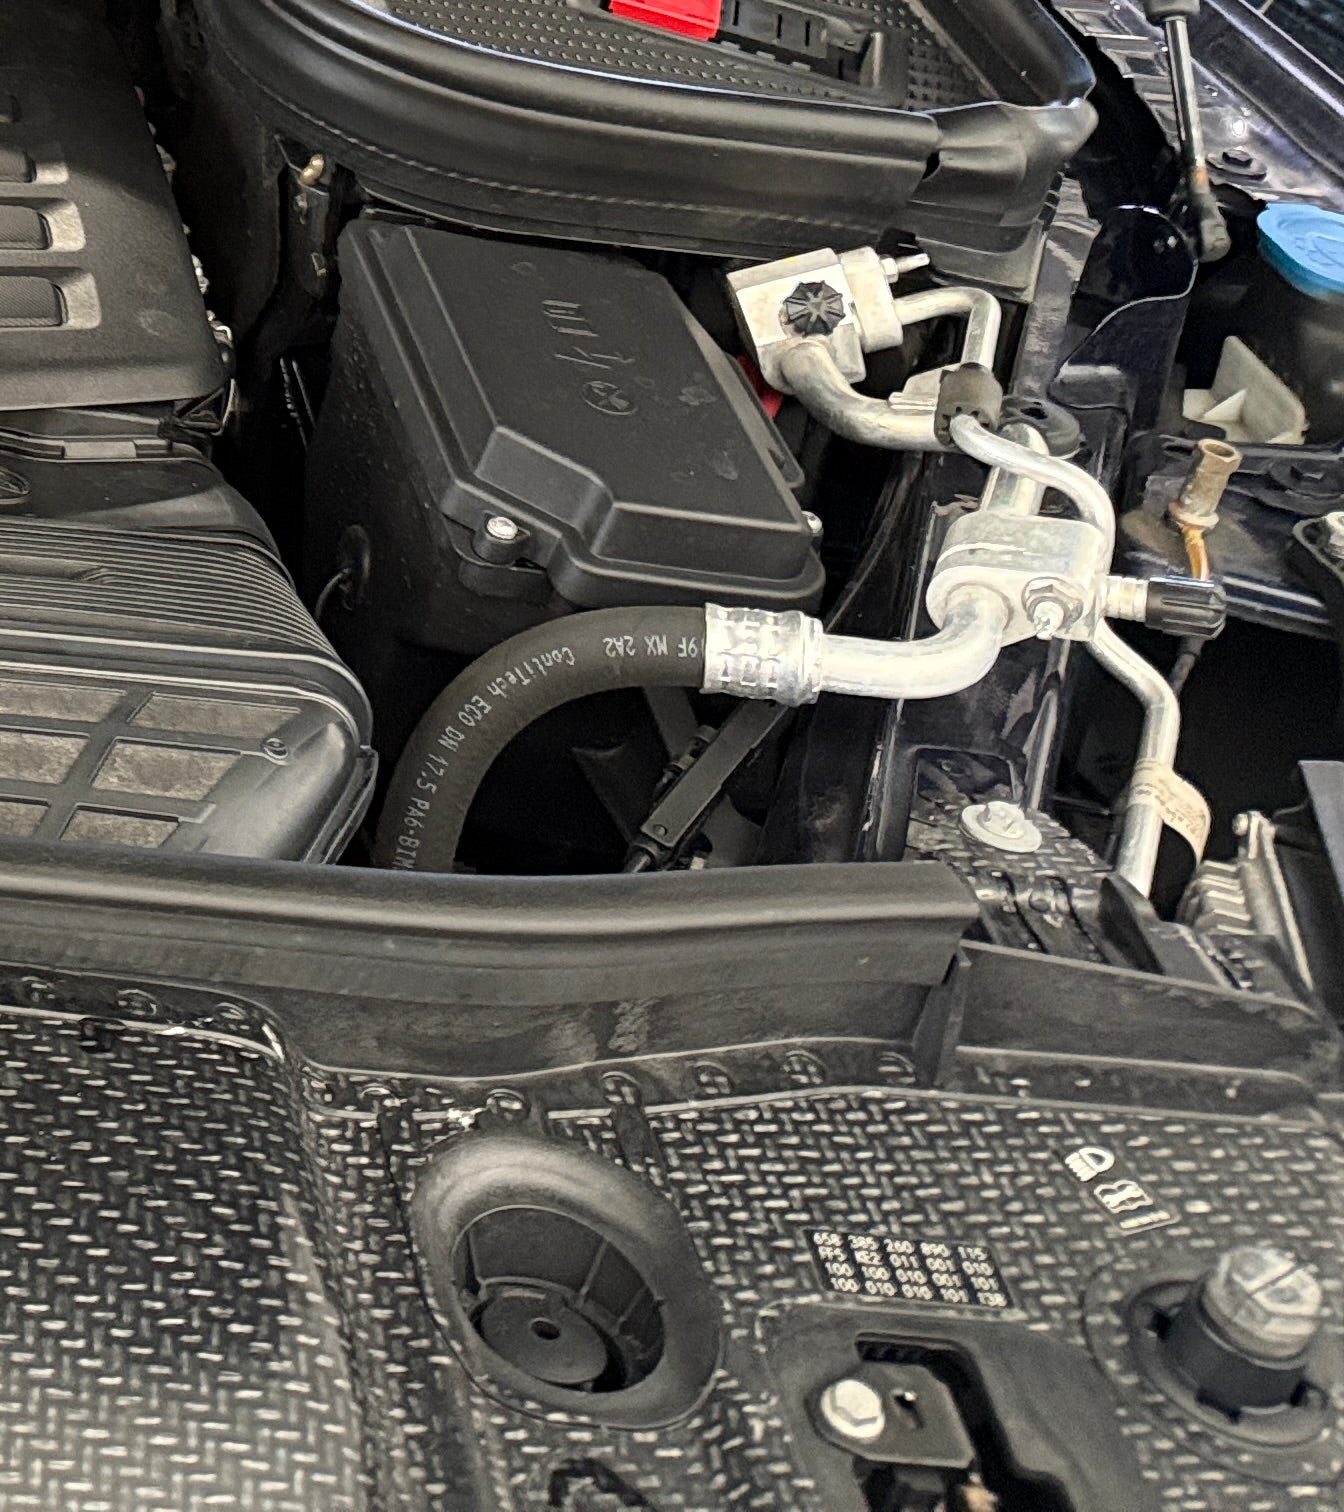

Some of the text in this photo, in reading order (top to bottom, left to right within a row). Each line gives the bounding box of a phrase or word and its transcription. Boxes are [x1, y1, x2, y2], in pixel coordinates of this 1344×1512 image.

[602, 634, 635, 657] 2A2
[486, 647, 576, 698] ContiTech
[458, 695, 492, 727] ECO
[417, 753, 448, 794] 17.5
[889, 1254, 920, 1268] 011
[962, 1261, 994, 1276] 010
[895, 1268, 928, 1284] 010
